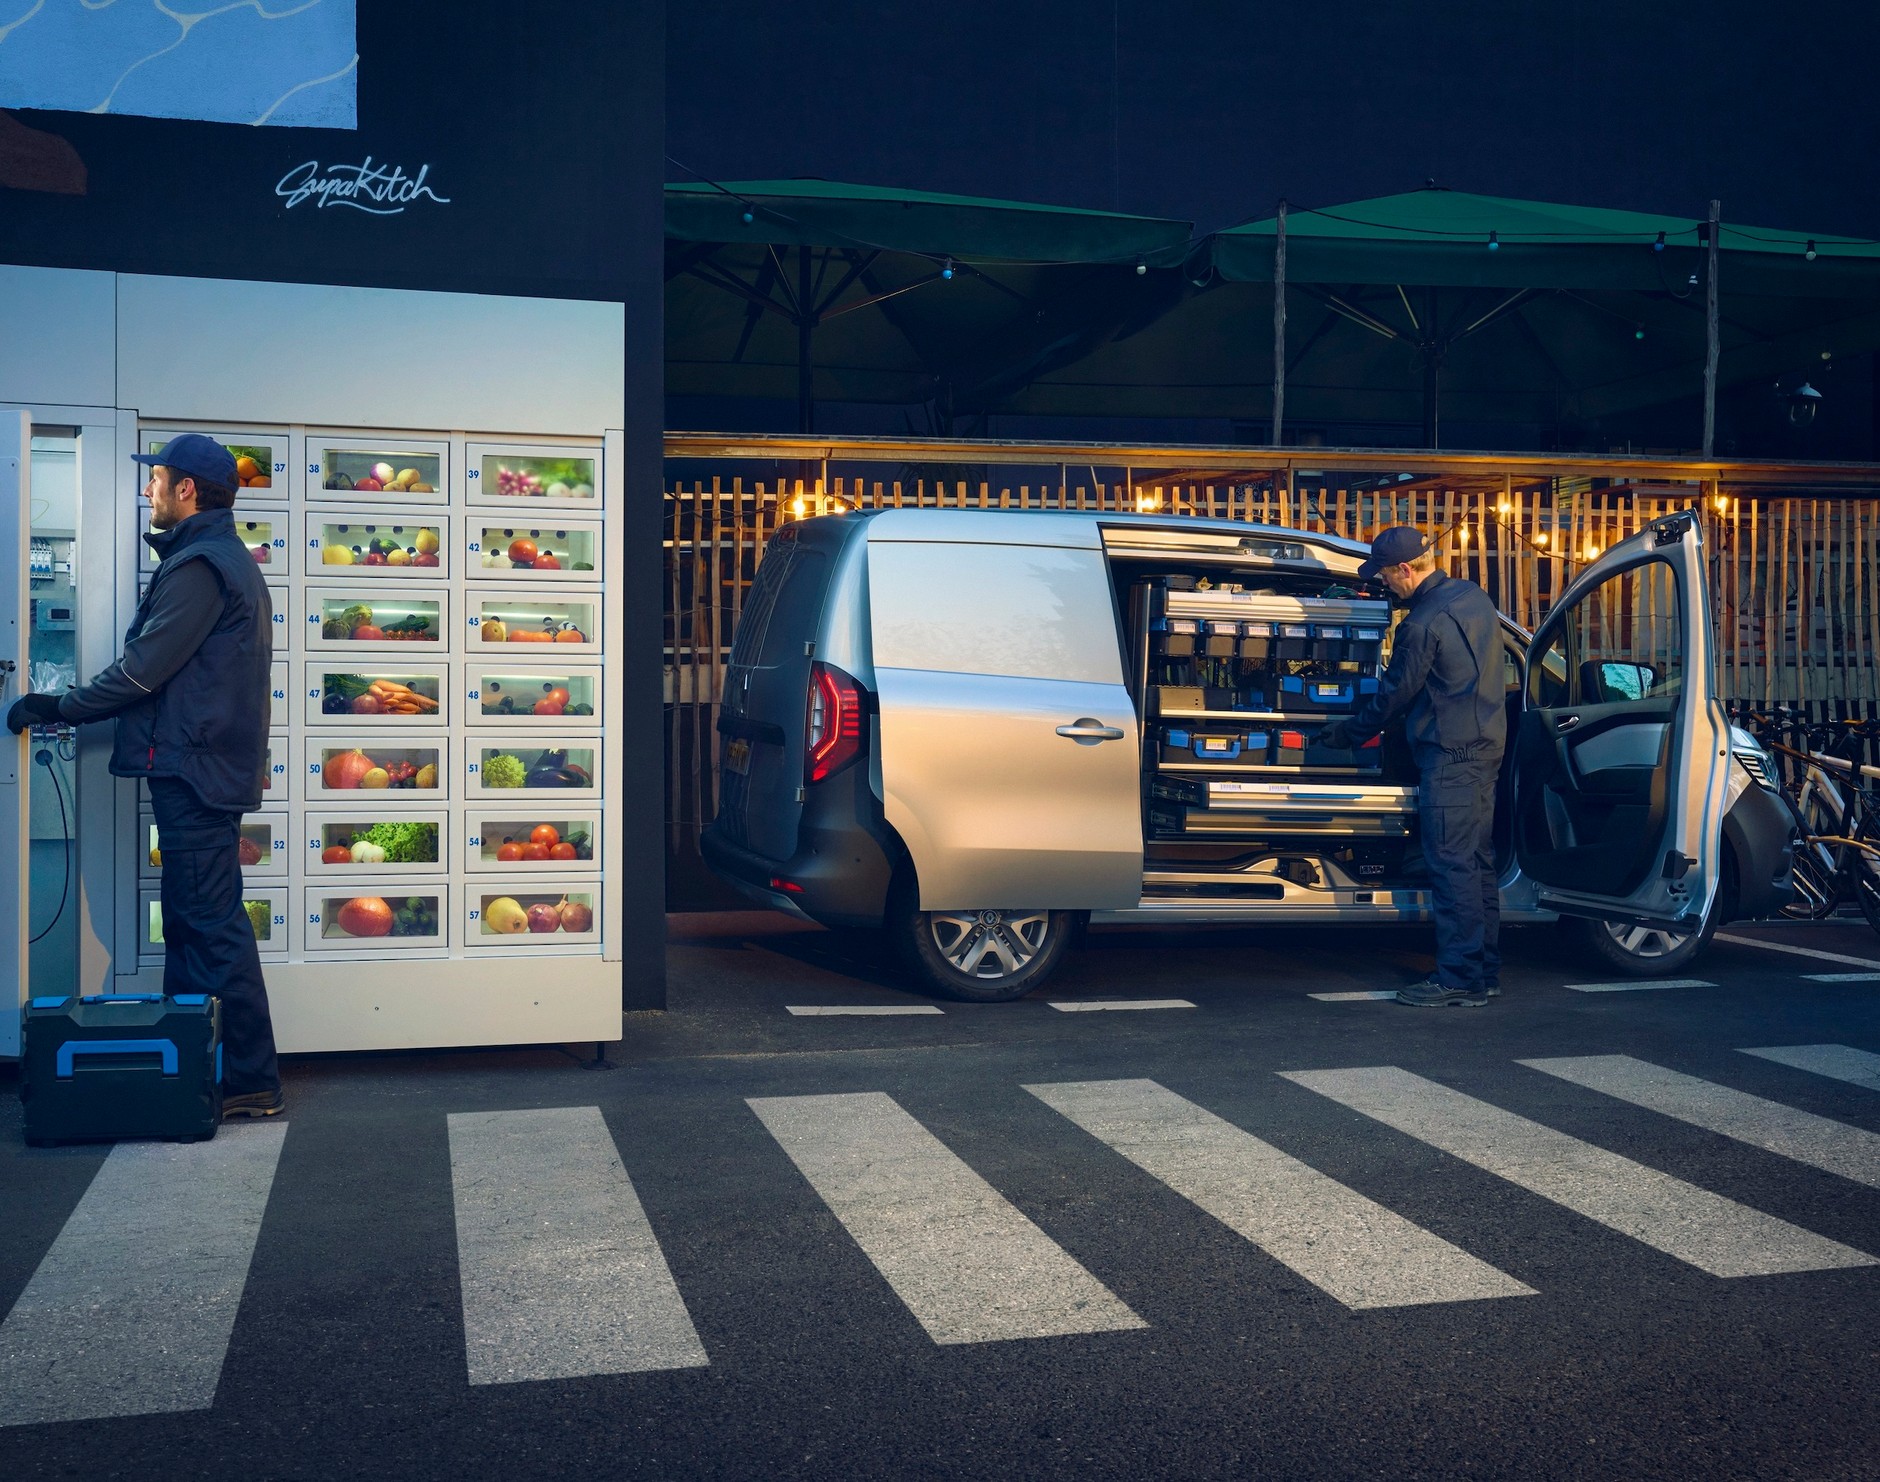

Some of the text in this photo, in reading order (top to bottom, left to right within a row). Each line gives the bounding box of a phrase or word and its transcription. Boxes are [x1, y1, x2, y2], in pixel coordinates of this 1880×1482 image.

[275, 155, 451, 214] SupaKitch
[274, 463, 286, 472] 37
[308, 464, 320, 474] 38
[468, 469, 480, 479] 39
[273, 538, 285, 548] 40
[309, 539, 319, 548] 41
[468, 543, 480, 552] 42
[272, 614, 285, 623] 43
[308, 614, 320, 624] 44
[468, 617, 479, 626] 45
[272, 690, 284, 699] 46
[309, 689, 321, 698] 47
[468, 690, 479, 700] 48
[273, 764, 285, 774] 49
[309, 764, 321, 774] 50
[468, 764, 478, 773] 51
[273, 840, 285, 850] 52
[309, 839, 321, 849] 53
[469, 837, 480, 846] 54
[273, 915, 285, 925] 55
[309, 914, 321, 923] 56
[469, 910, 480, 920] 57
